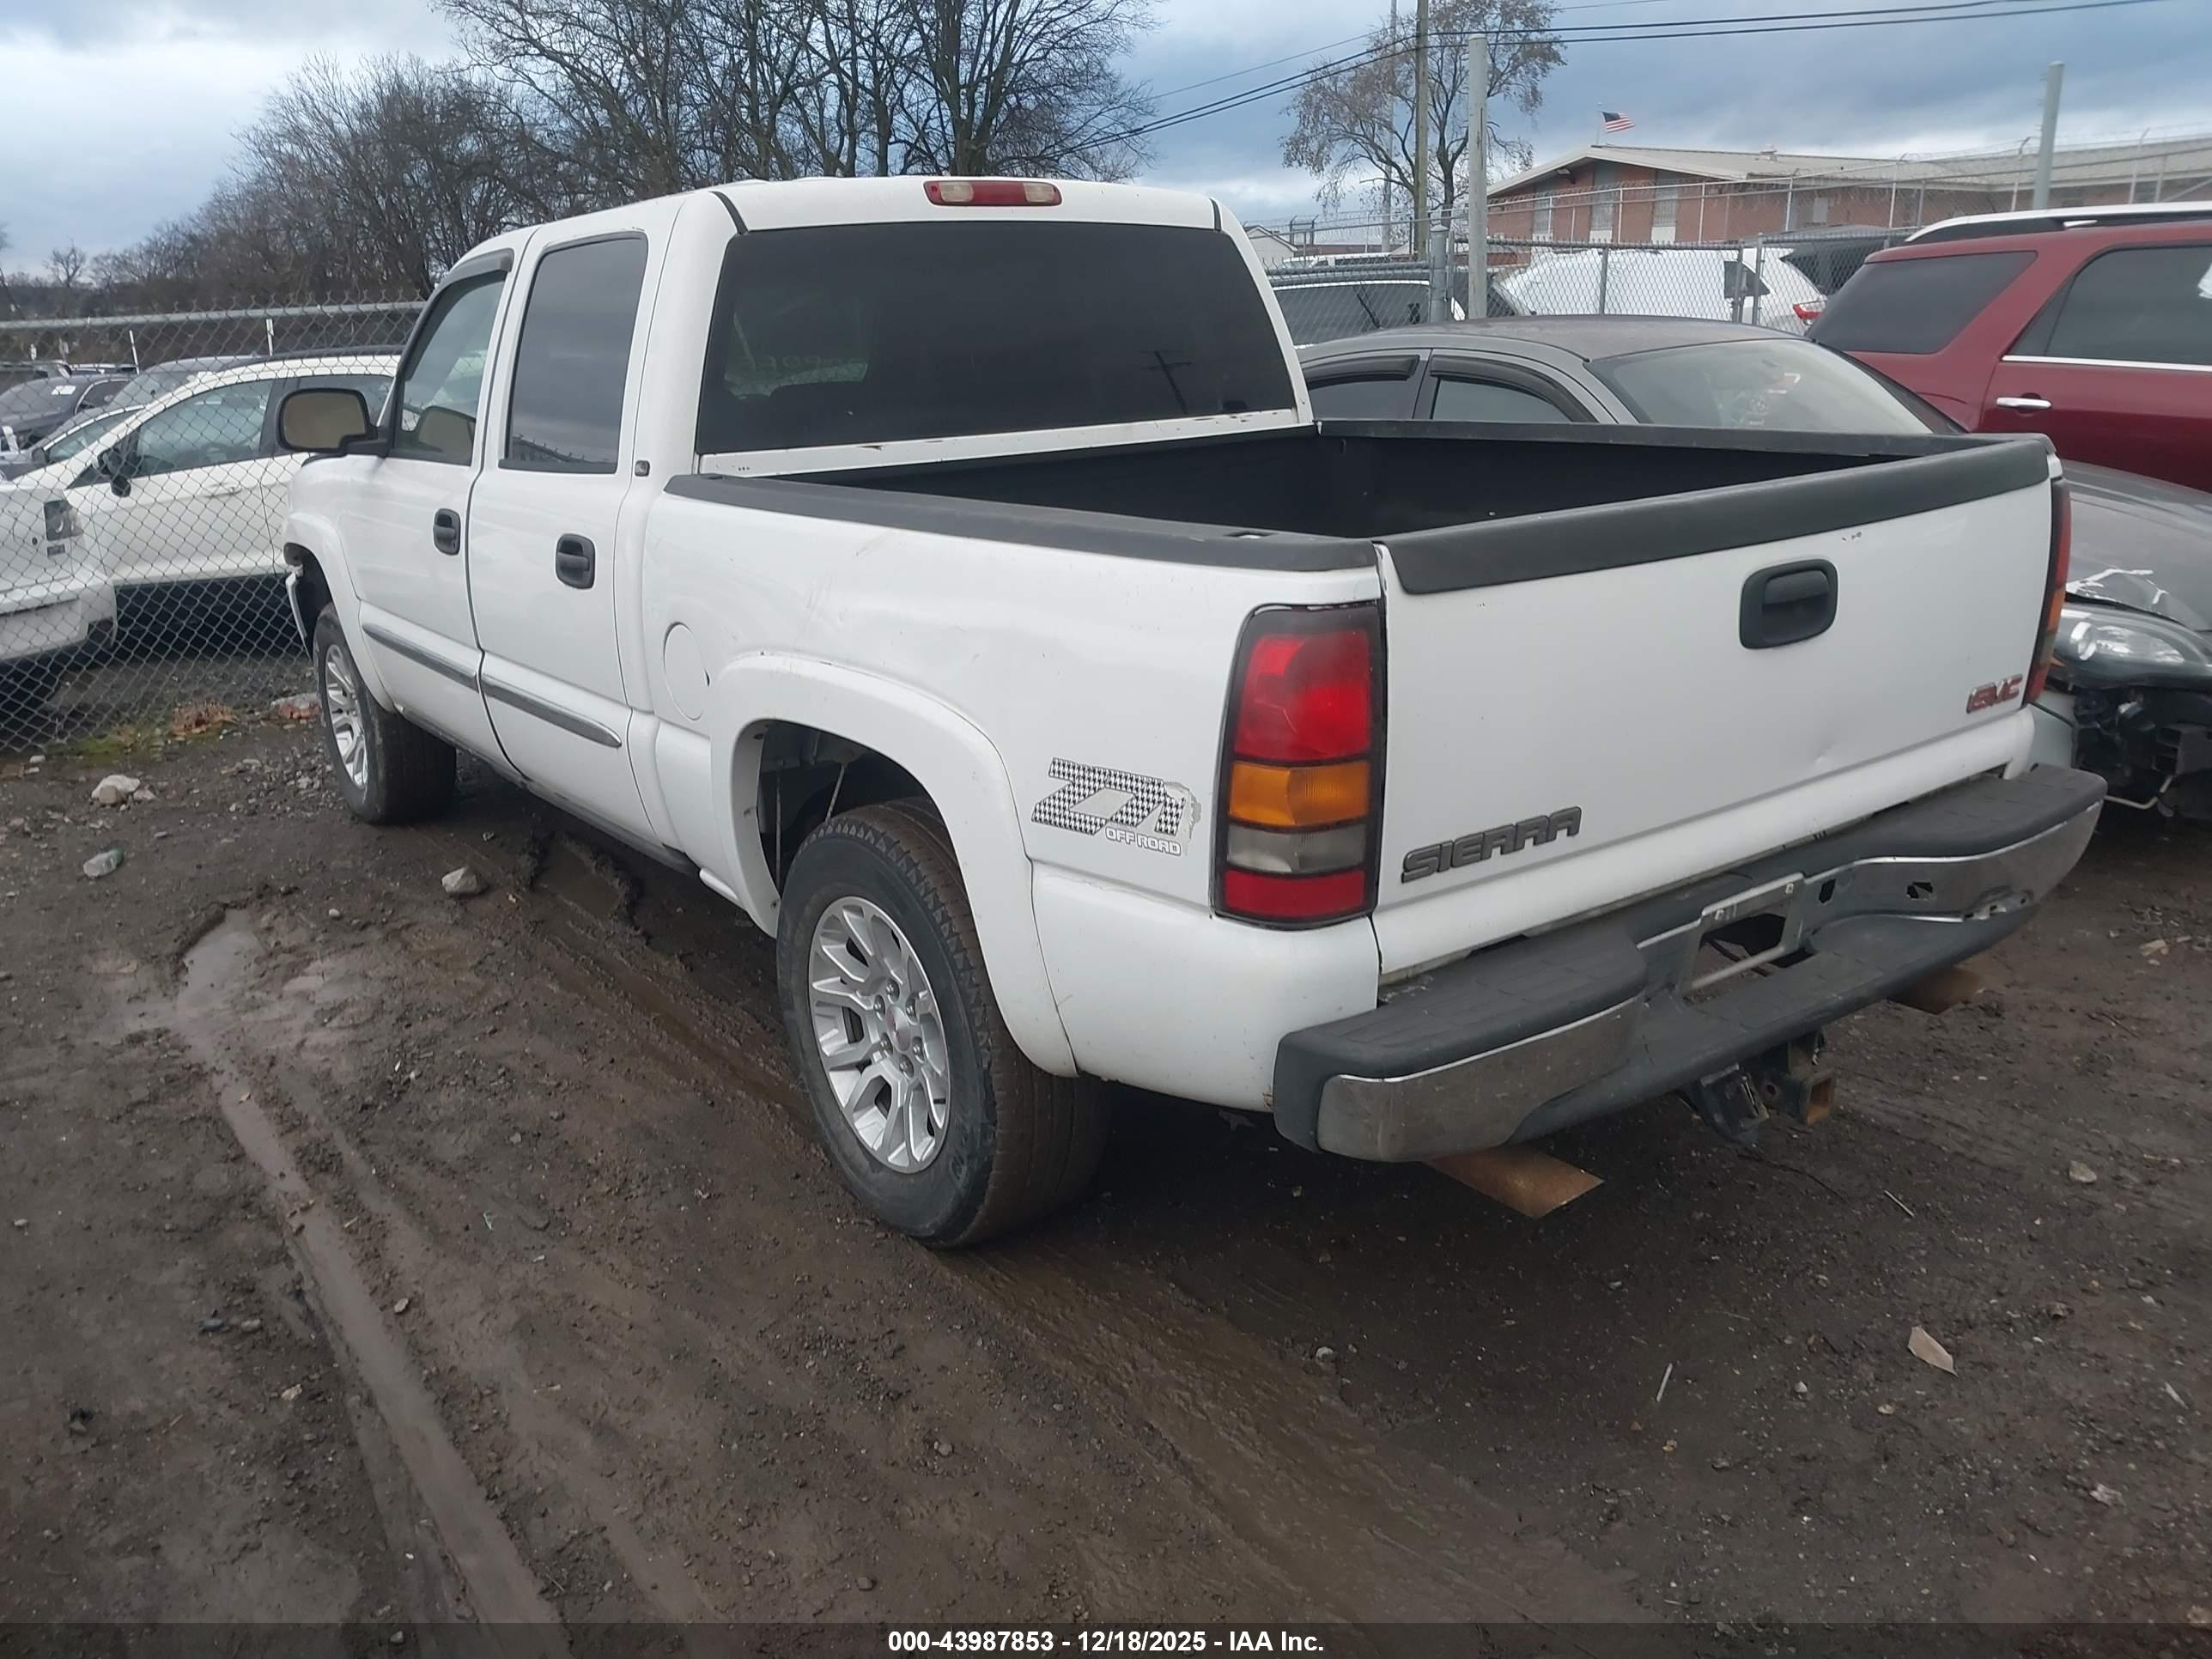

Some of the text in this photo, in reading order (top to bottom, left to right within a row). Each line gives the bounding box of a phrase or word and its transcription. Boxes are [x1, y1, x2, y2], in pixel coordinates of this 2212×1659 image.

[1966, 673, 2023, 714] GMC
[1030, 757, 1186, 836] Z71
[1104, 826, 1182, 856] OFF ROAD
[1401, 806, 1582, 883] SIERRA
